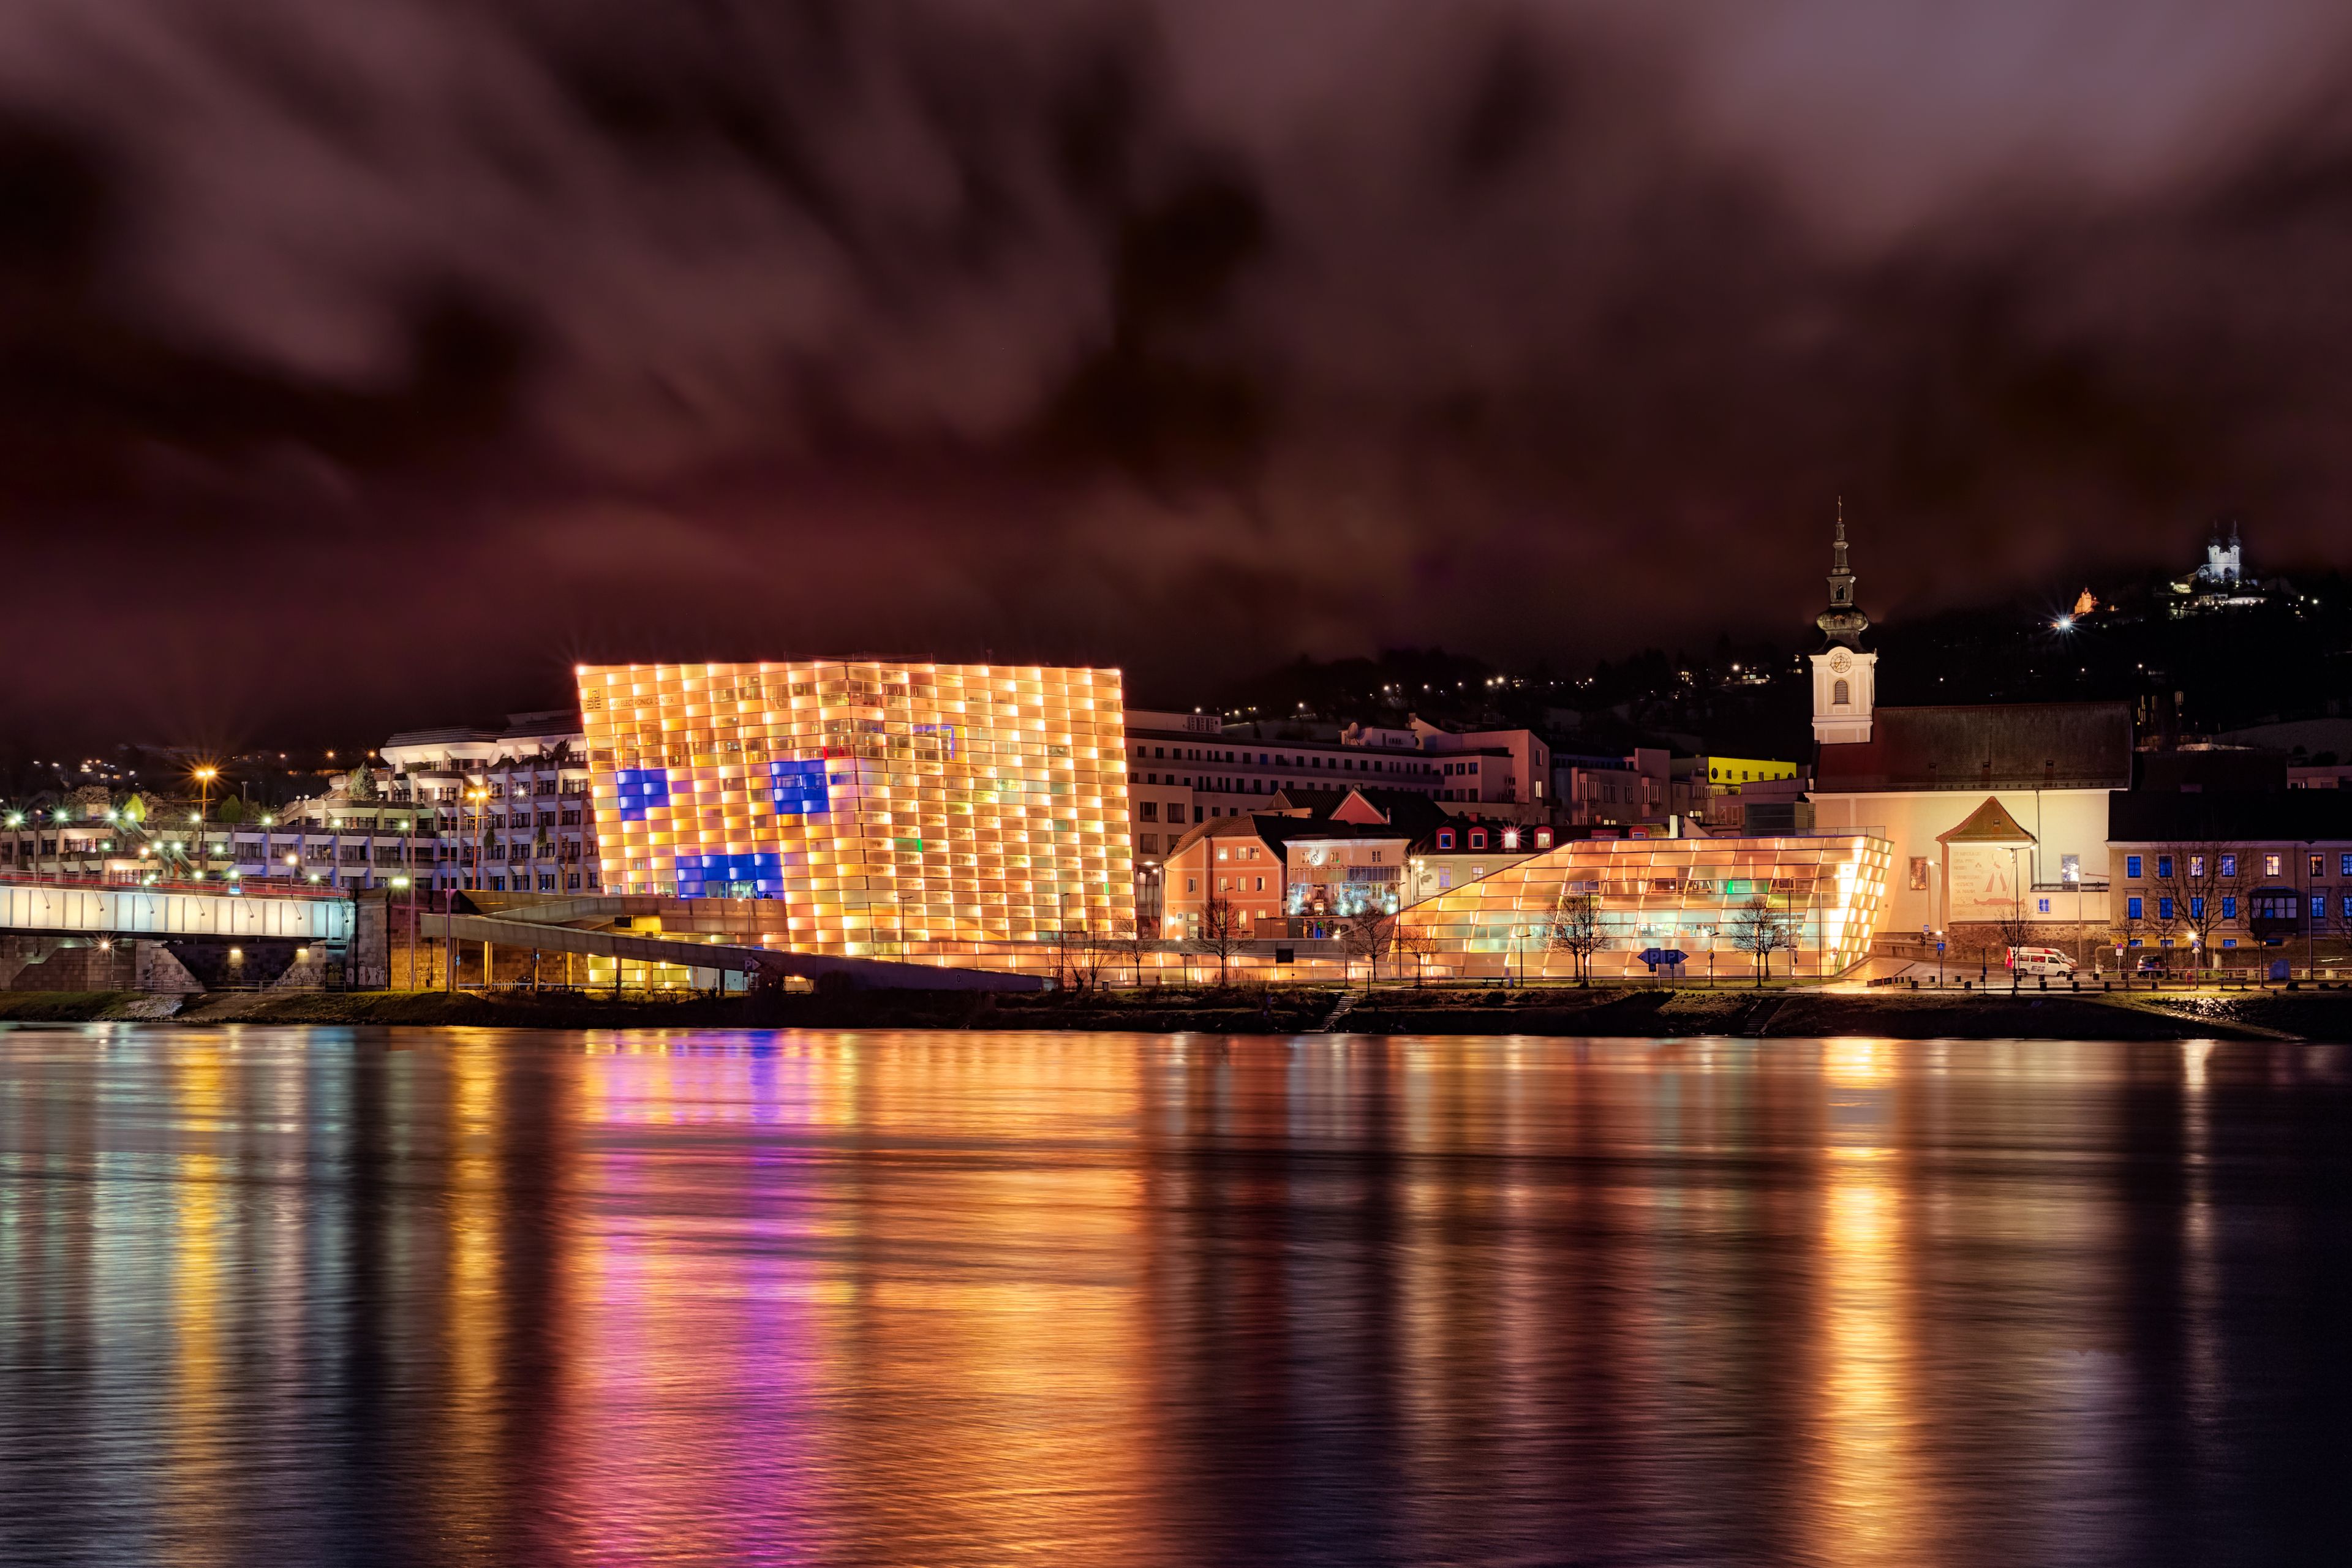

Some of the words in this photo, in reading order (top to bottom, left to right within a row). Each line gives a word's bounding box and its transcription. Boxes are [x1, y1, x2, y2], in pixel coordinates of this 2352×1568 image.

[620, 696, 653, 707] ELECTRONICA
[1668, 952, 1676, 962] P
[744, 960, 752, 970] P
